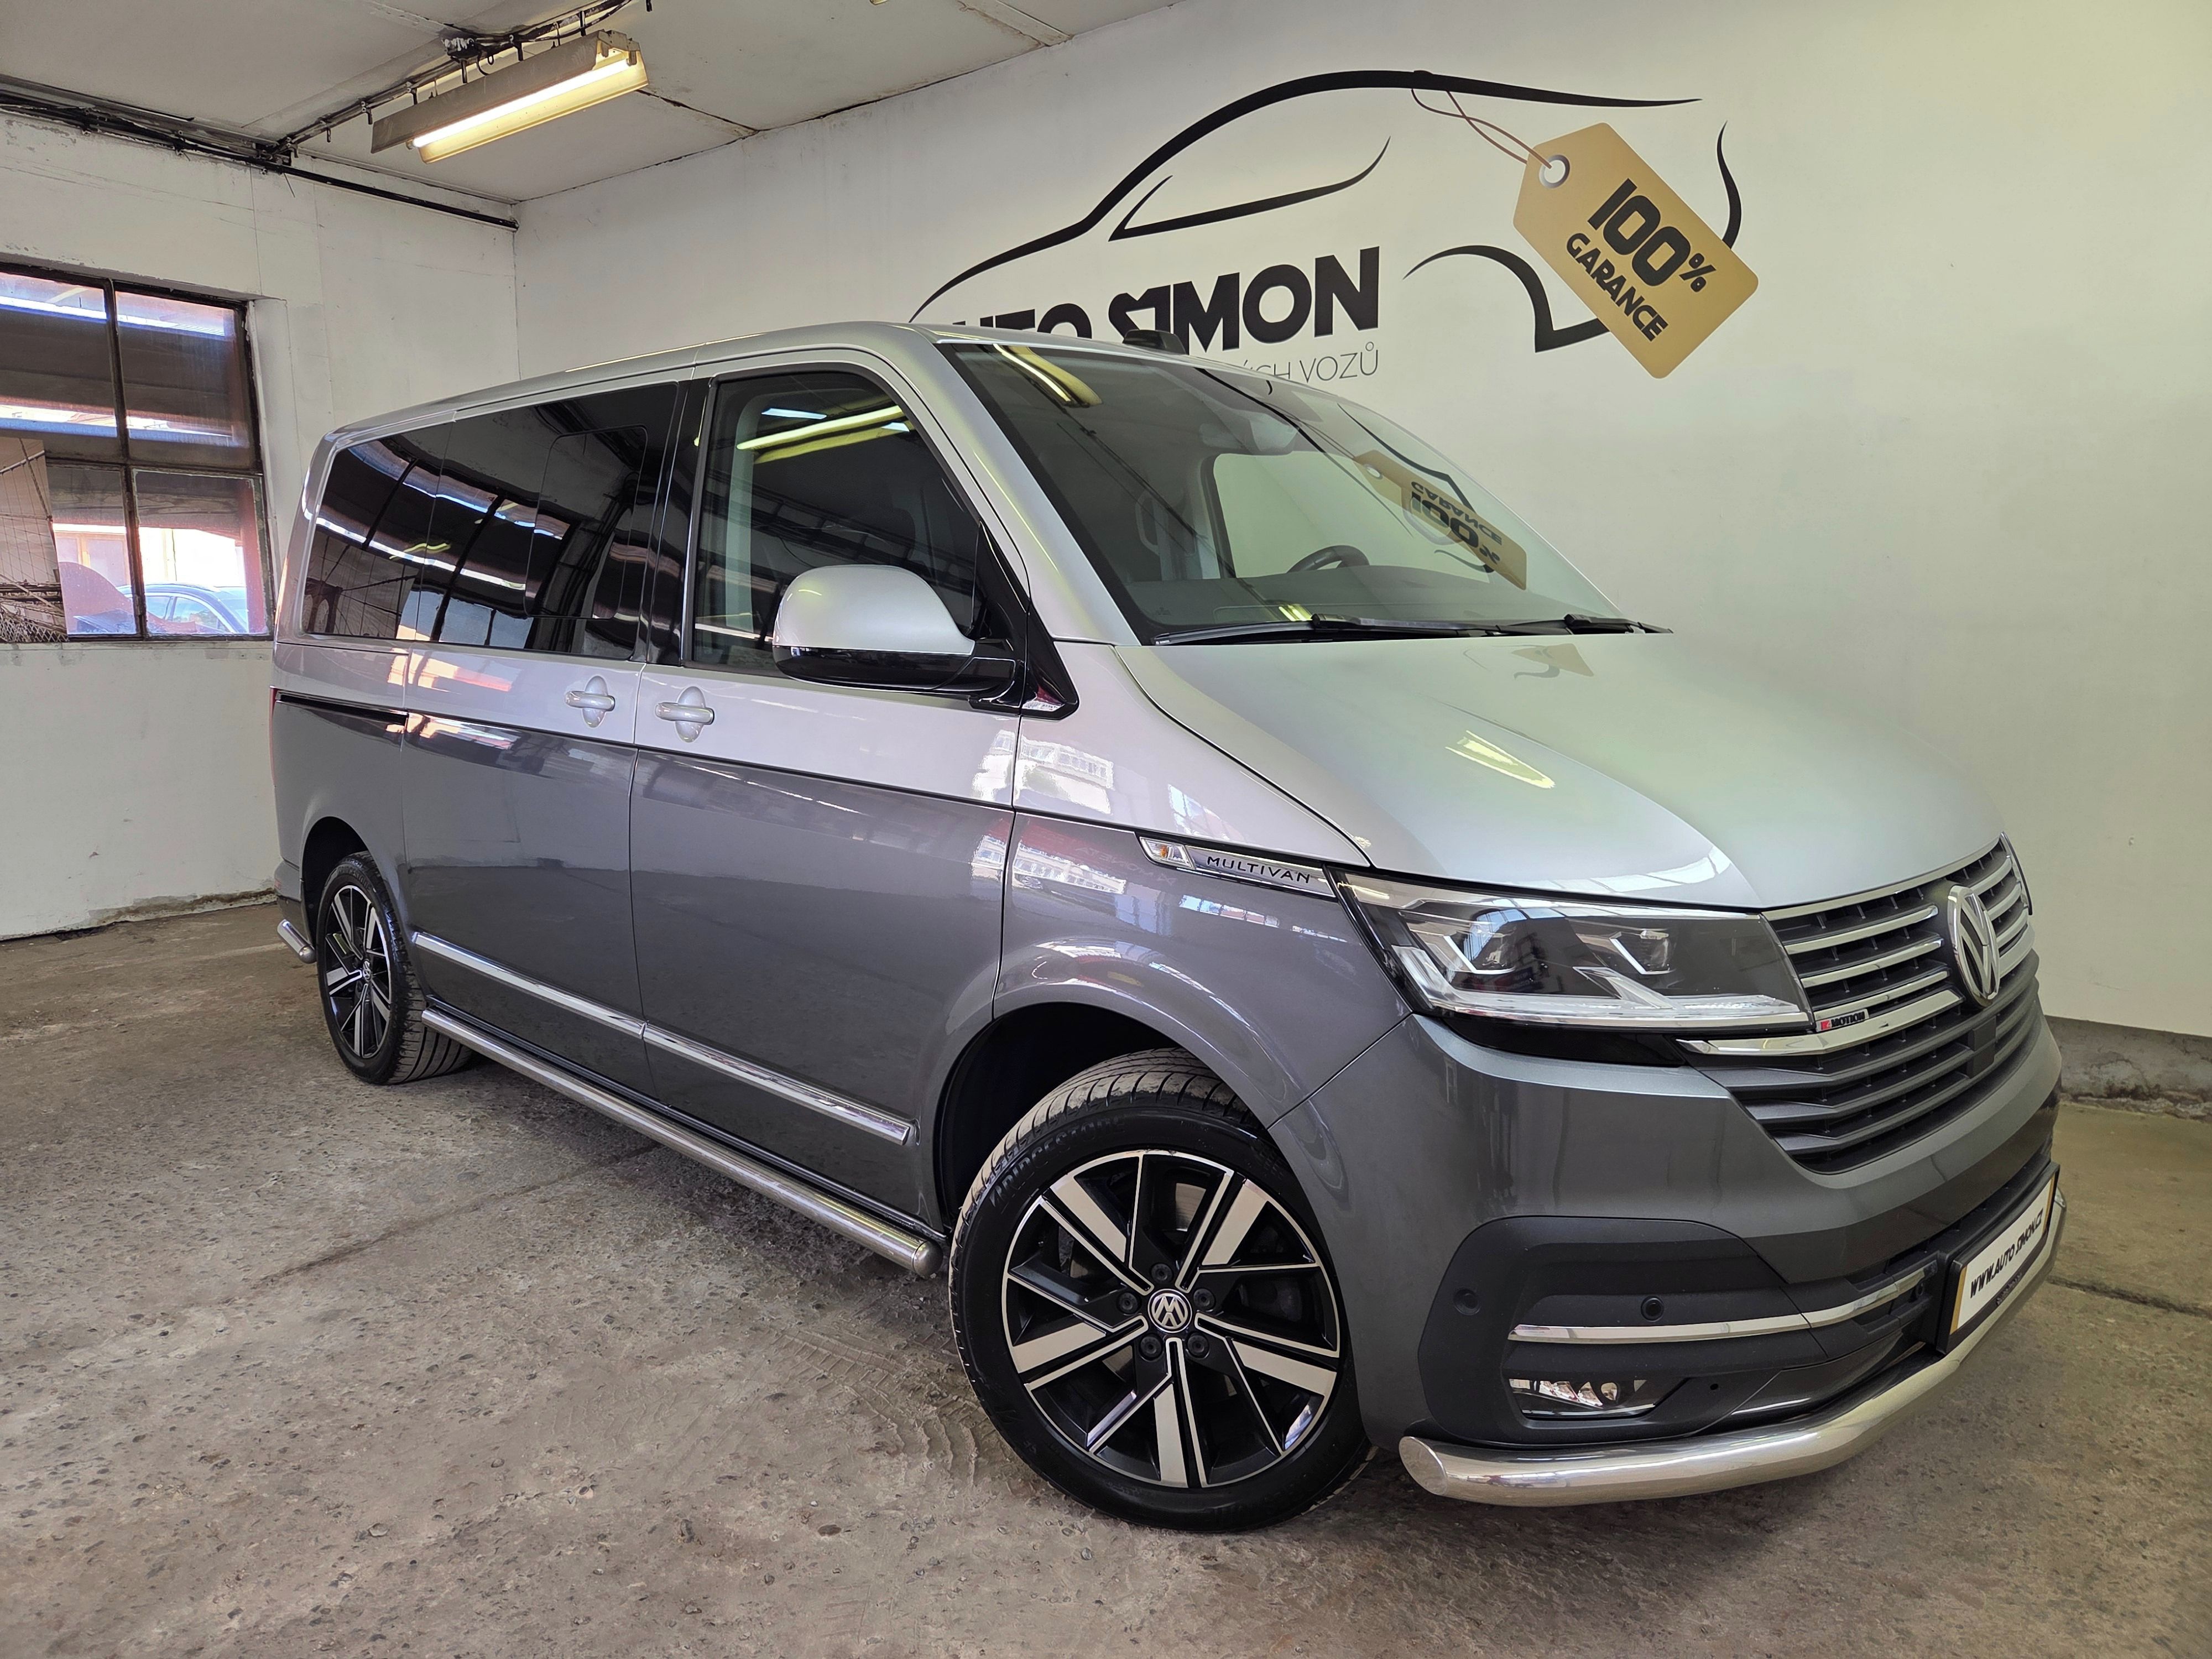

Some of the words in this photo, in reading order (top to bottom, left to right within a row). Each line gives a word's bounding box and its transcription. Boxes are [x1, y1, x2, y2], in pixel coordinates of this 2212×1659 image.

[1587, 178, 1716, 293] 100%
[1567, 232, 1668, 341] GARANCE
[1300, 342, 1378, 383] VOZŮ
[1207, 856, 1310, 884] MULTIVAN
